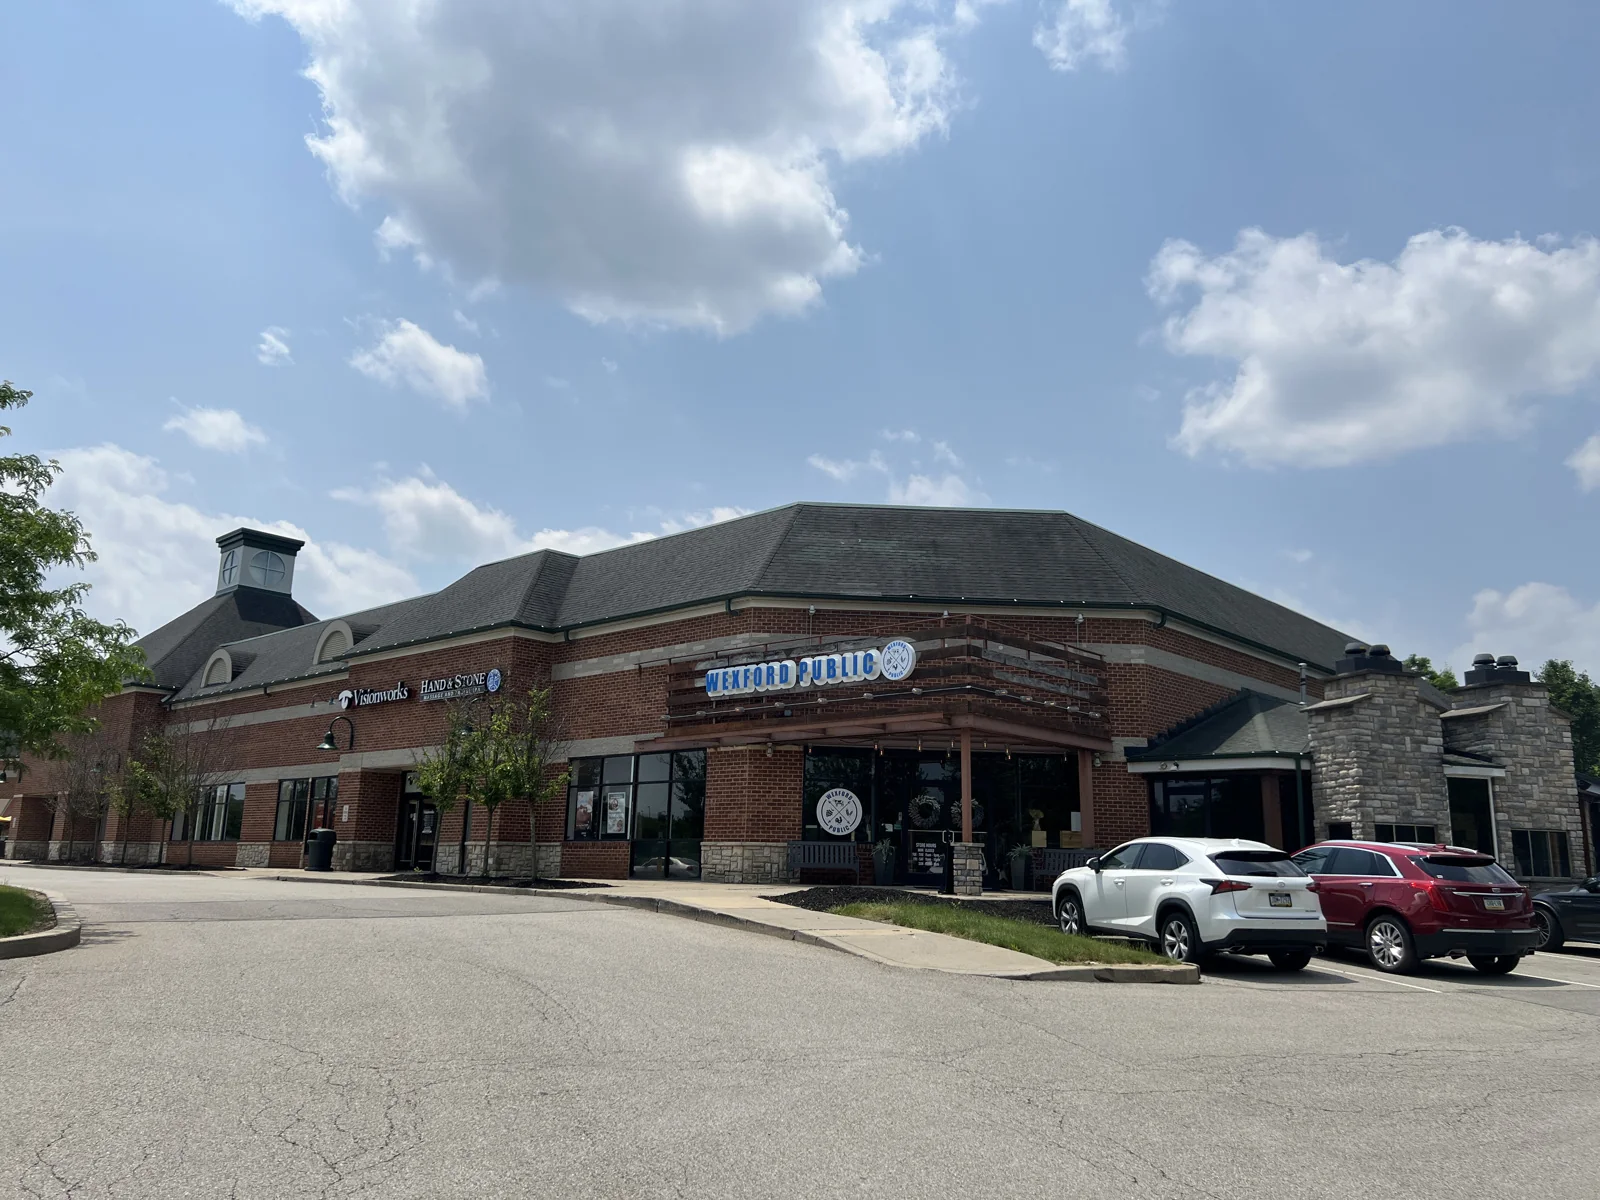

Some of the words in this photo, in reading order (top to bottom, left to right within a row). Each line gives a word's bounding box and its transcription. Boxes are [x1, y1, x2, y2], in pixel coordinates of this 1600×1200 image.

[420, 679, 447, 694] HAND
[447, 678, 454, 689] &
[454, 672, 487, 689] STONE
[706, 663, 789, 693] WEXFORD
[799, 652, 874, 682] PUBLIC
[353, 681, 409, 706] Visionworks
[826, 790, 853, 800] WEXFORD
[828, 824, 850, 833] PUBLIC
